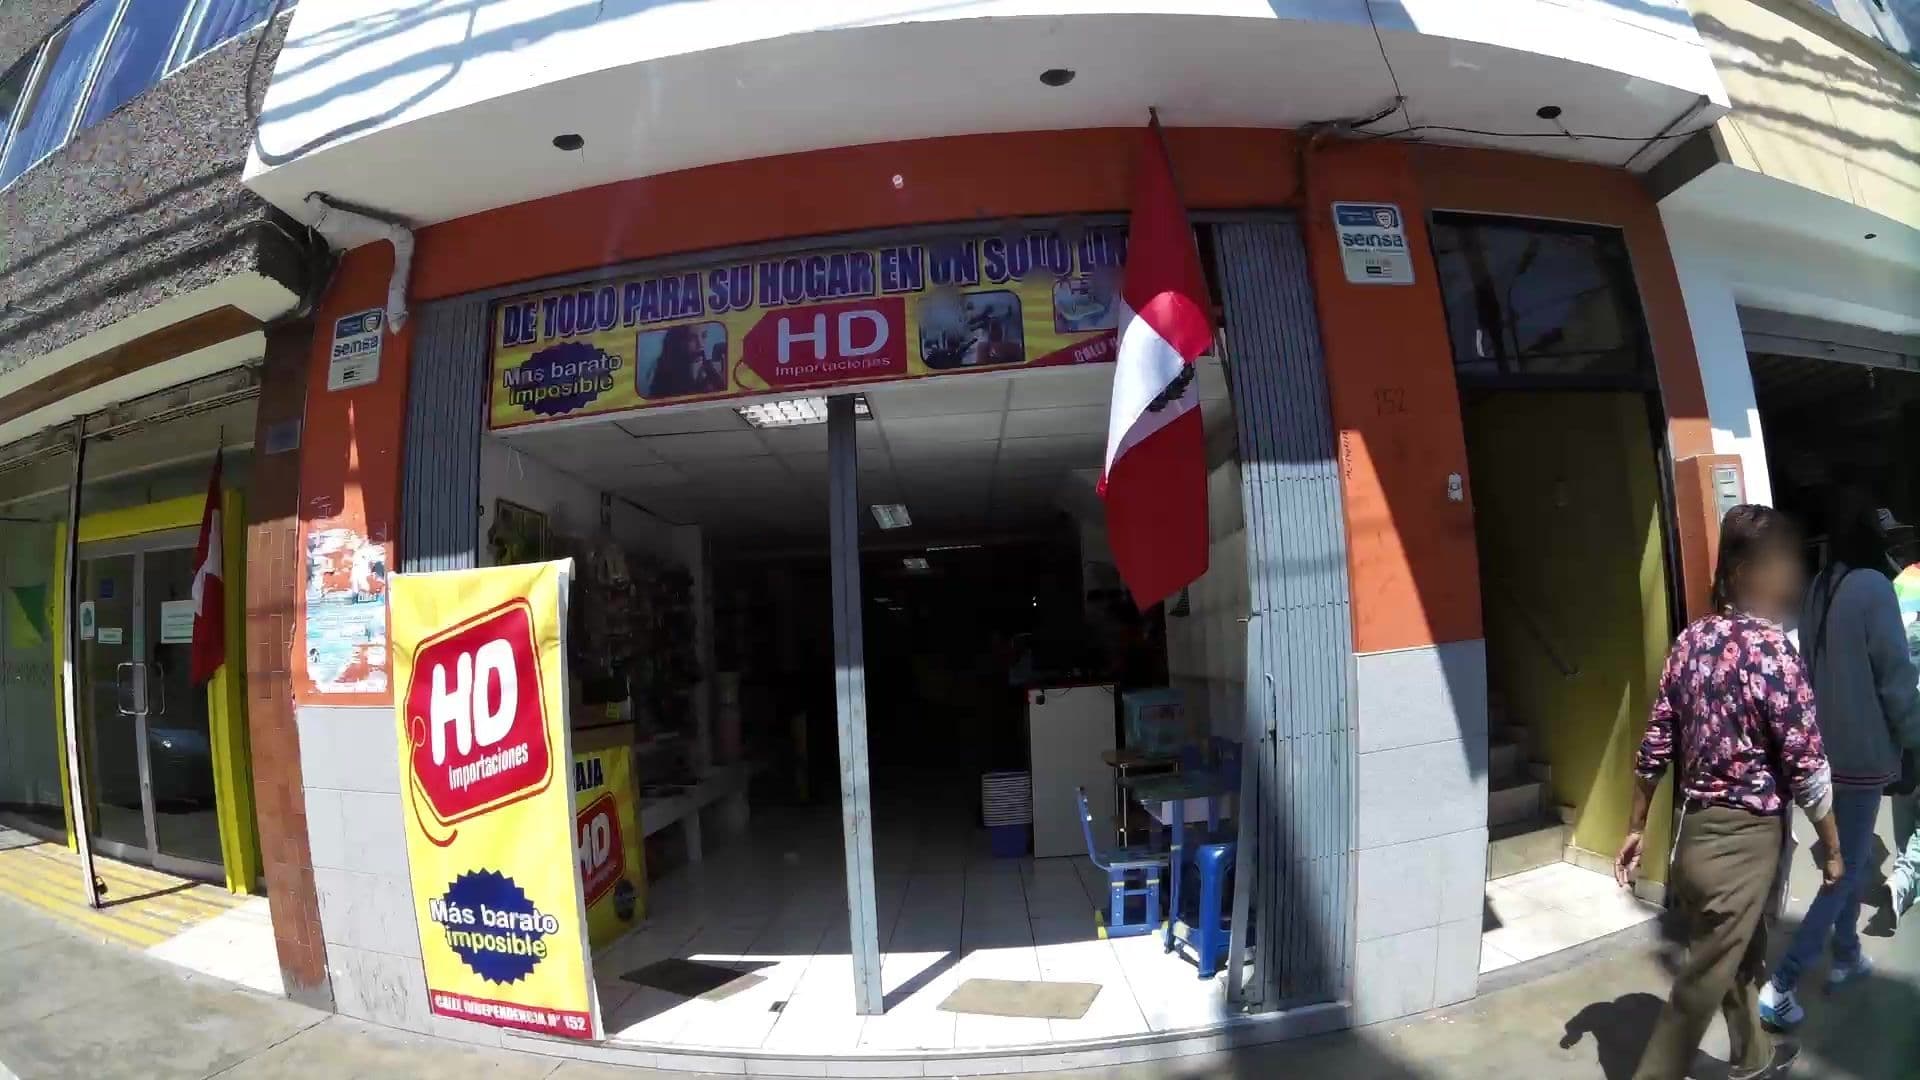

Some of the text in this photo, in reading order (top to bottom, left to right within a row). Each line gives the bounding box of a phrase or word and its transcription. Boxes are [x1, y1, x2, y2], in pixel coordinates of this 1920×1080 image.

[503, 303, 538, 347] DE
[541, 285, 617, 338] TODO
[624, 273, 704, 326] PARA
[709, 265, 754, 313] SU
[760, 251, 874, 307] HOGAR
[880, 246, 924, 293] EN
[928, 238, 979, 287] UN
[984, 233, 1073, 284] SOLO
[778, 310, 889, 364] HD
[551, 353, 623, 379] barato
[776, 357, 891, 377] Importaciones
[430, 638, 518, 766] HD
[430, 899, 558, 934] Más barato
[446, 927, 547, 958] imposible
[563, 1015, 586, 1031] 152
